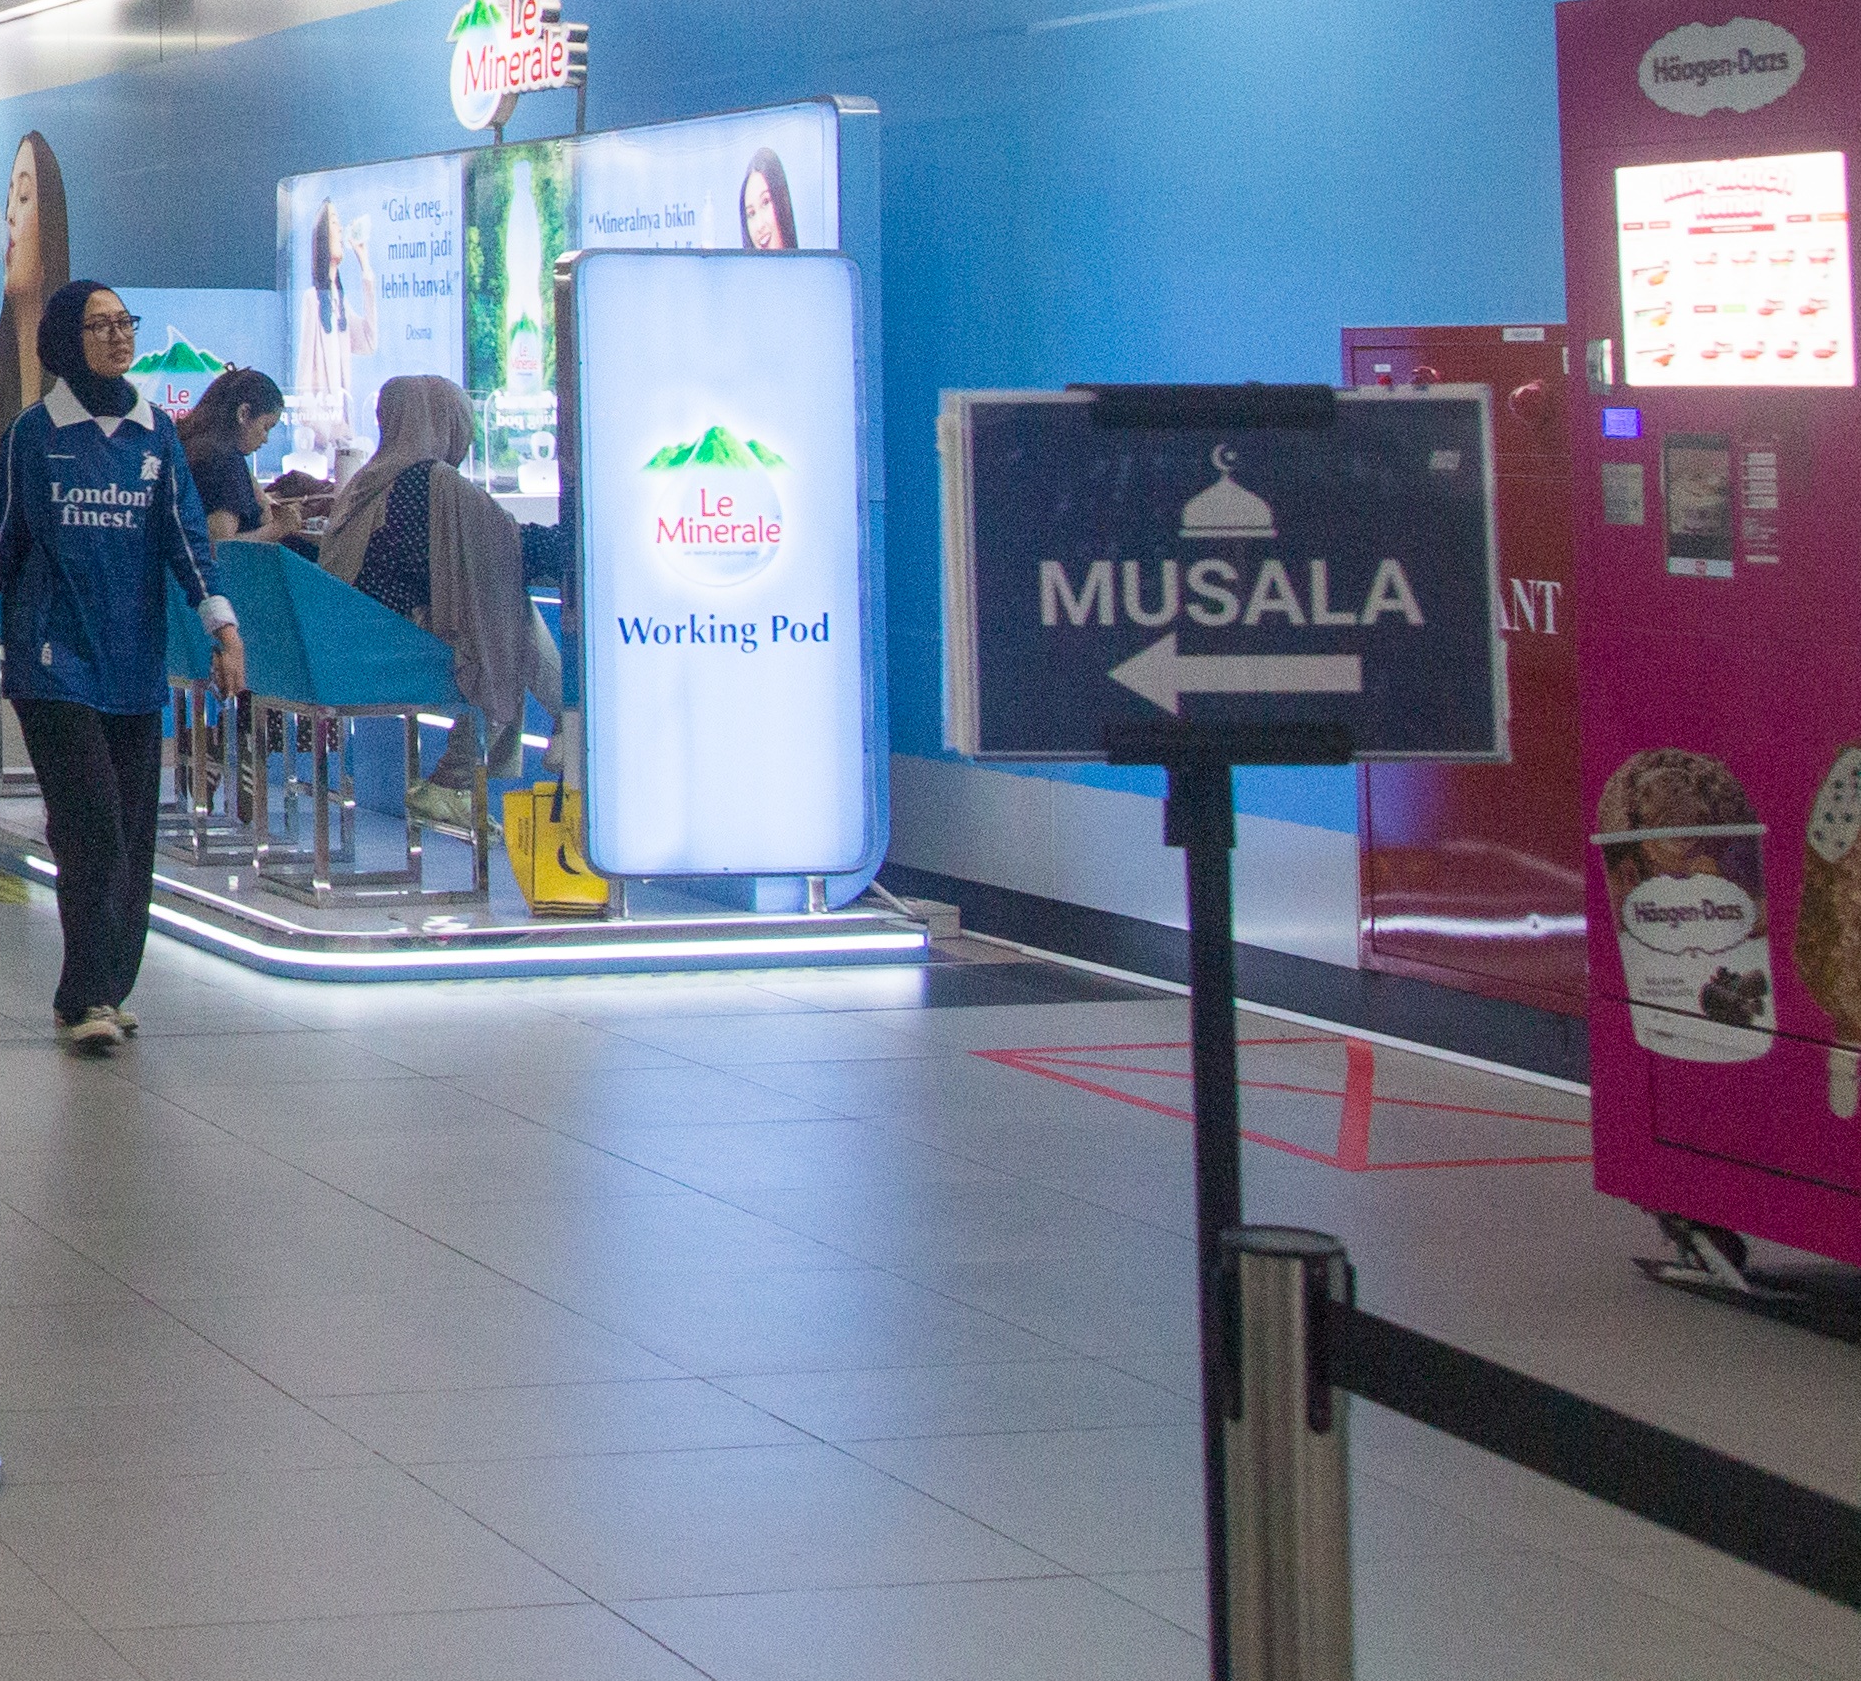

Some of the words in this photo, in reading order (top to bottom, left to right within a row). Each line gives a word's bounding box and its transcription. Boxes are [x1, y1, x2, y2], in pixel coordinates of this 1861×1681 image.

[463, 31, 565, 97] Minerale
[1652, 47, 1789, 86] Häagen-Dazs
[664, 202, 695, 228] bikin
[387, 238, 427, 261] minum
[429, 231, 452, 264] jadi
[380, 274, 409, 300] lebih
[166, 384, 190, 405] Le
[61, 503, 137, 529] finest.
[701, 487, 734, 517] Le
[656, 514, 781, 544] Minerale
[1039, 559, 1424, 628] MUSALA
[616, 615, 757, 653] Working
[771, 611, 832, 644] Pod
